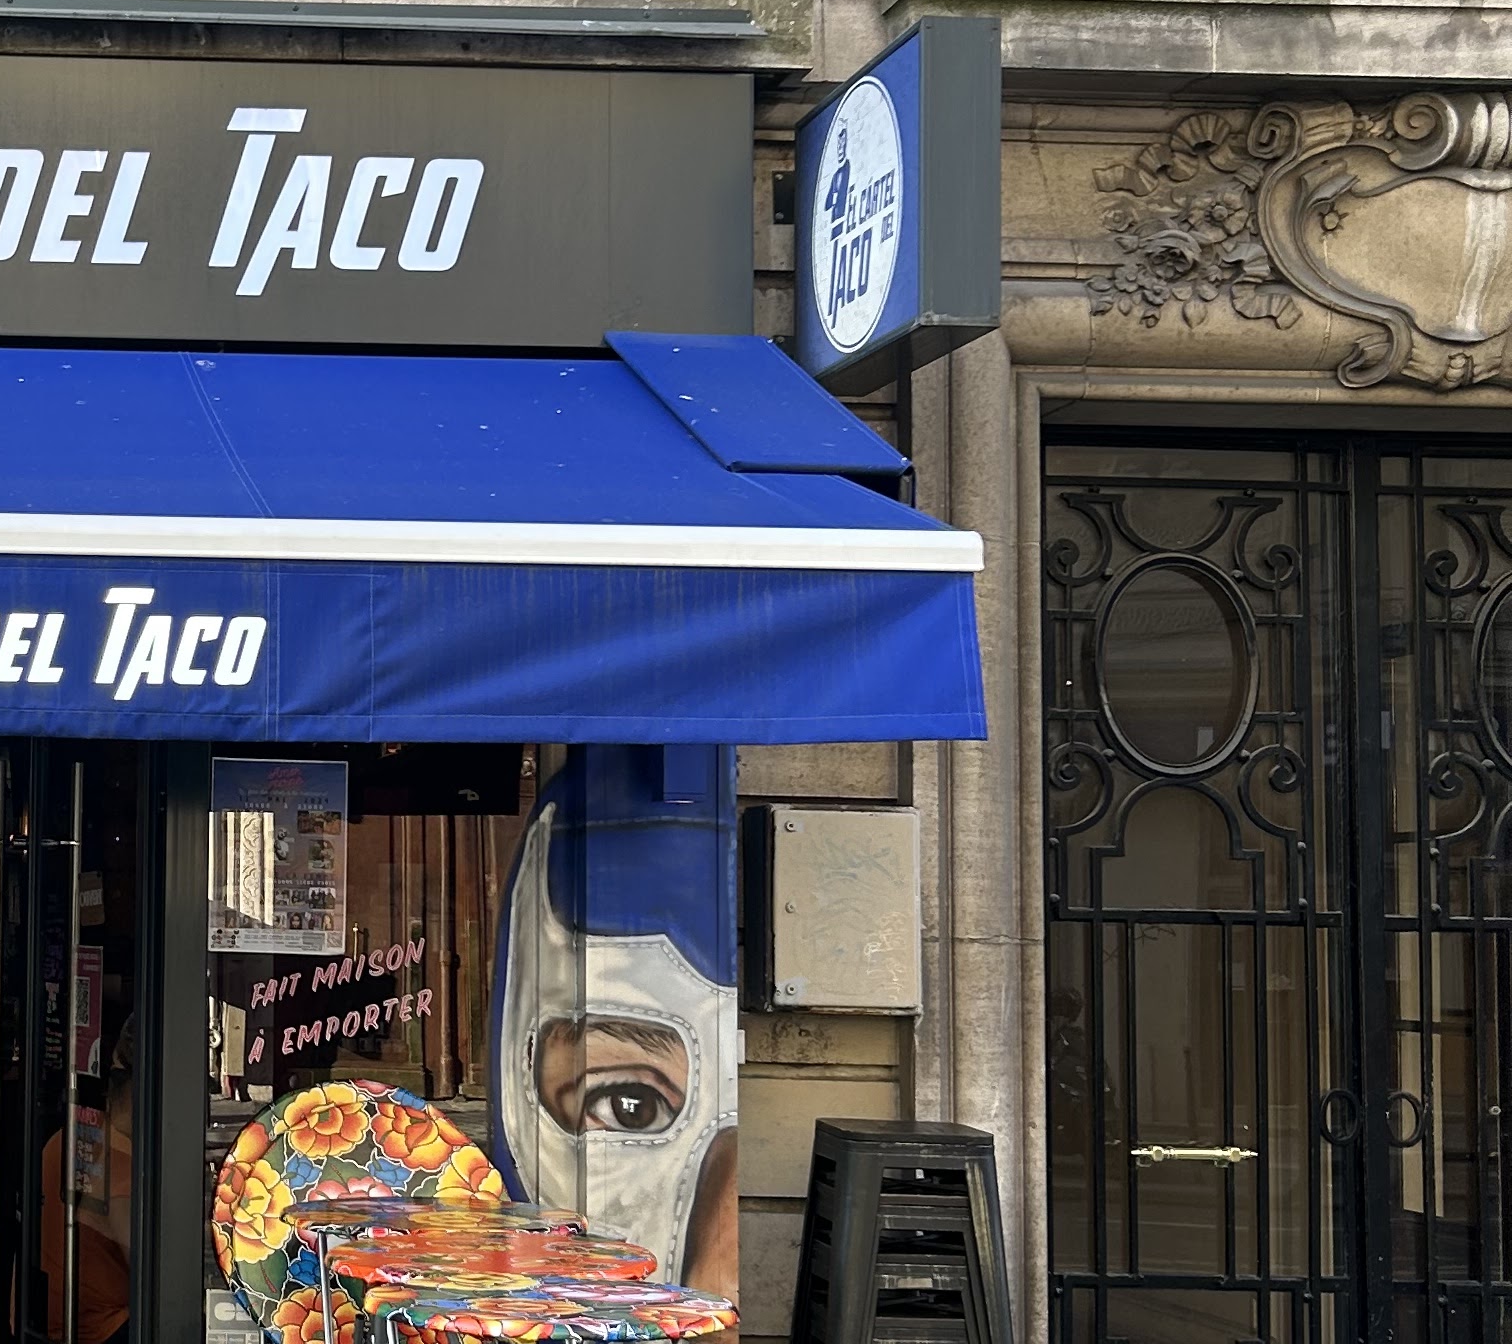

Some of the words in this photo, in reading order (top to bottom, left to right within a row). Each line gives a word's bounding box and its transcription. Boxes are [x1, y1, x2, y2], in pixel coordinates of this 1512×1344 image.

[208, 108, 485, 297] TACO
[827, 223, 872, 329] TACO
[93, 587, 267, 701] TACO
[251, 972, 301, 1009] FAIT
[311, 937, 425, 992] MAISON
[281, 988, 433, 1055] EMPORTER
